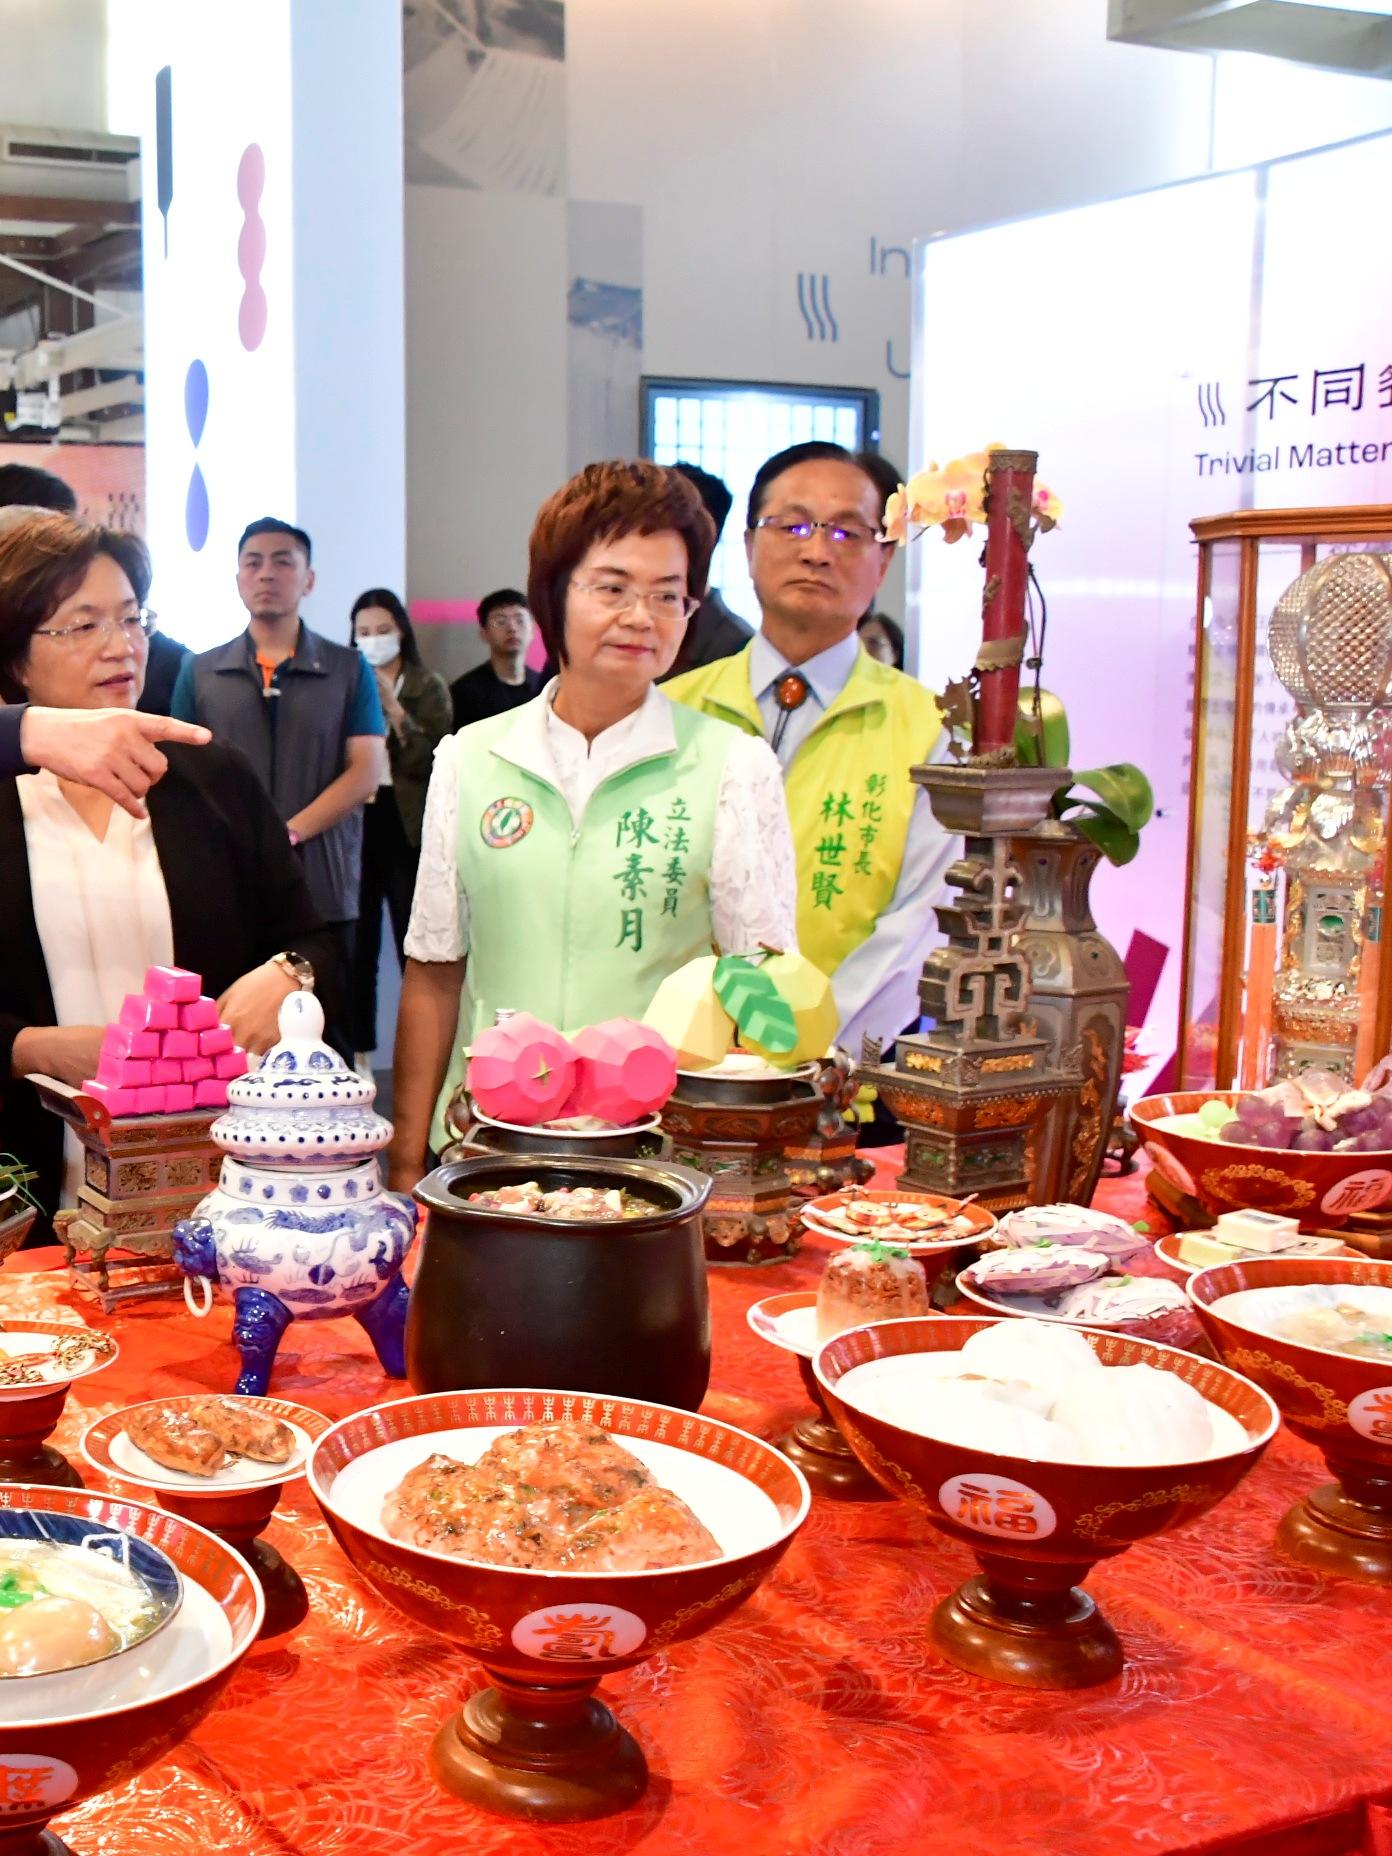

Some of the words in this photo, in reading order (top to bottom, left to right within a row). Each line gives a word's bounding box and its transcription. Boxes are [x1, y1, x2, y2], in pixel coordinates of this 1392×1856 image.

[1246, 363, 1392, 420] 不同
[1195, 447, 1280, 476] Trivial
[612, 808, 660, 952] 陳素月
[660, 797, 692, 918] 立法委員
[811, 792, 856, 911] 林世賢
[853, 773, 887, 876] 彰化市長
